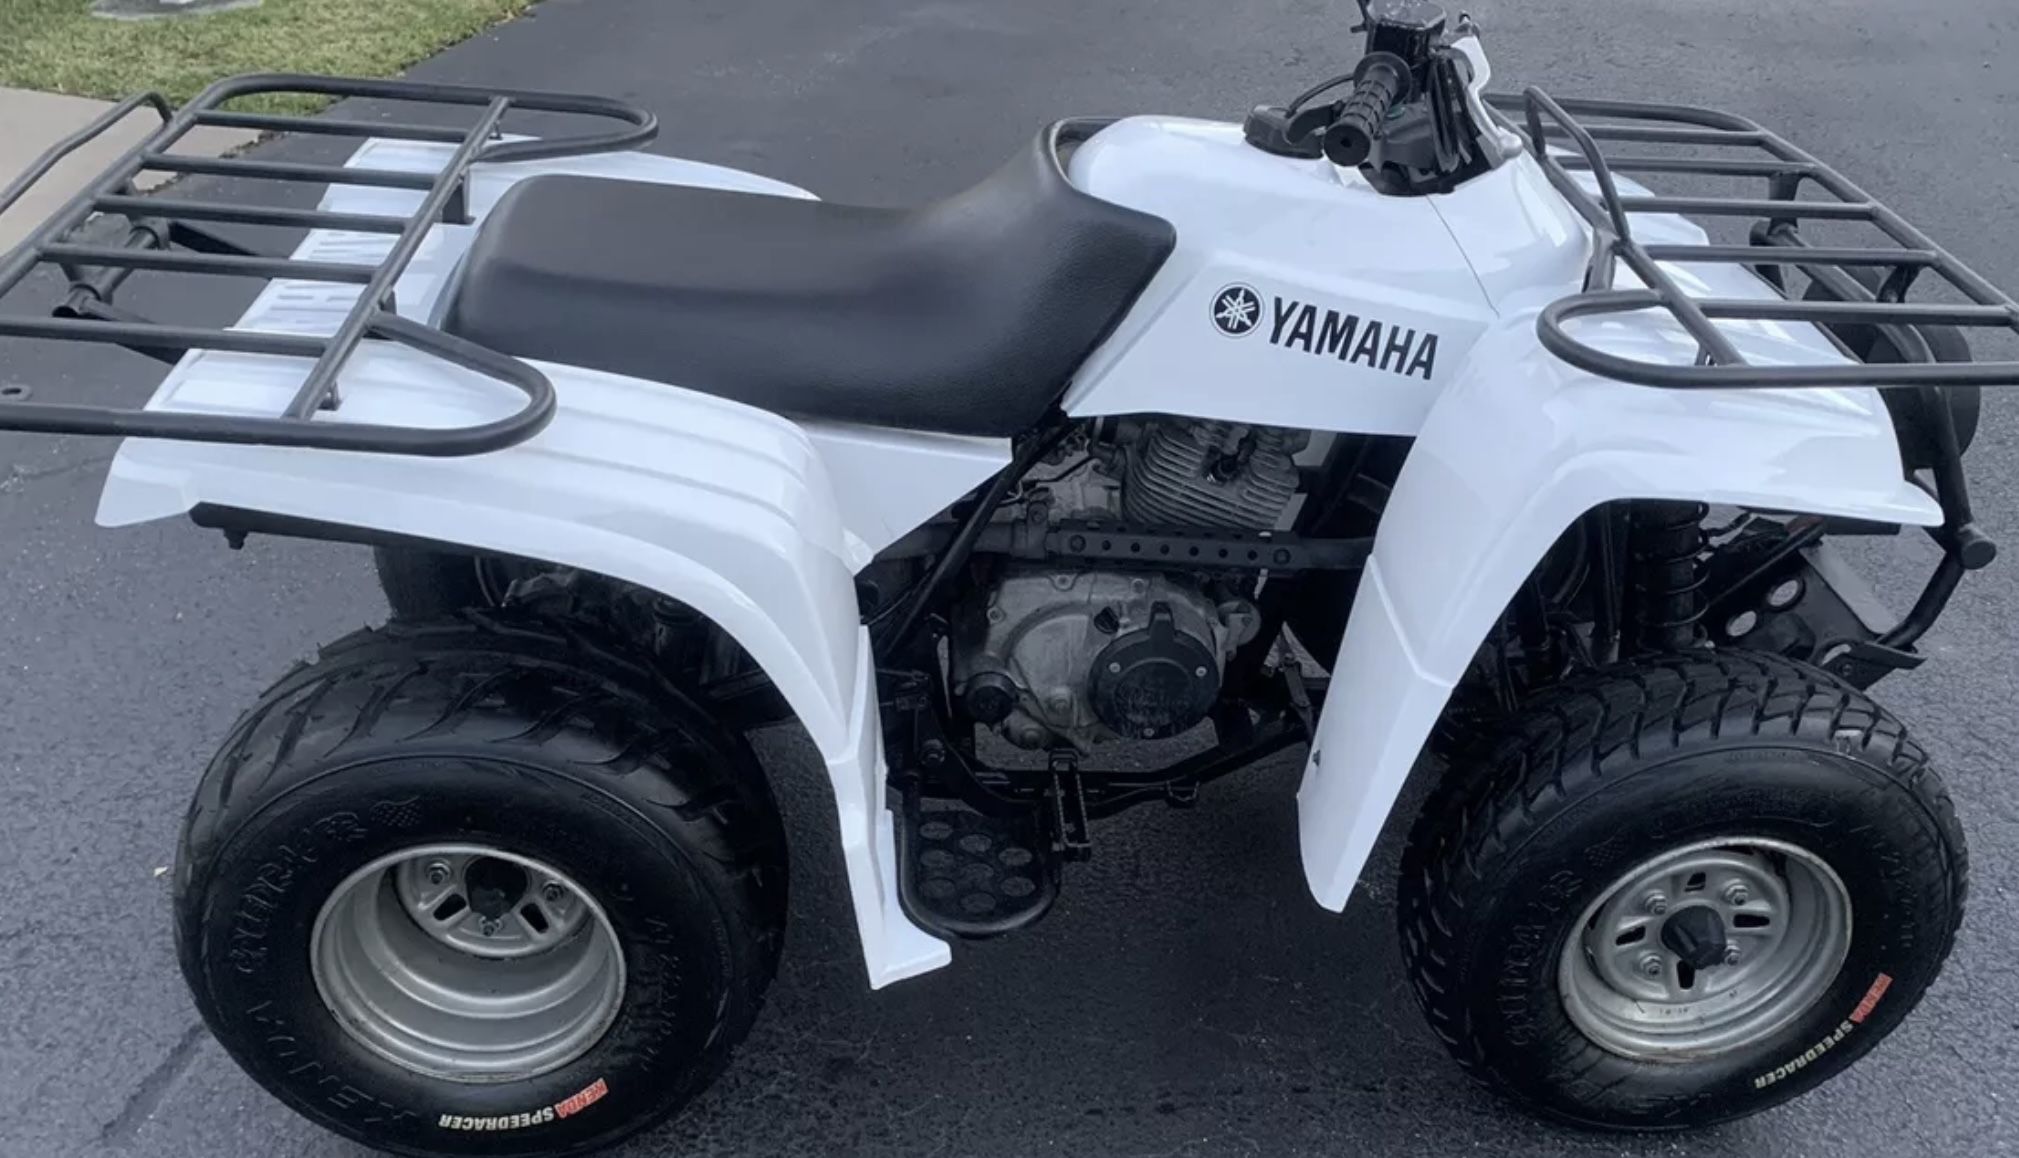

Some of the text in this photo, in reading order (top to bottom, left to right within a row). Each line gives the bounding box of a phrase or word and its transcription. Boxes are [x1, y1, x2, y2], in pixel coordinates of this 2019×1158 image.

[1270, 296, 1438, 380] YAMAHA
[1754, 1019, 1854, 1089] SPEEDRACER
[438, 1077, 608, 1131] KENDA SPEEDRACER
